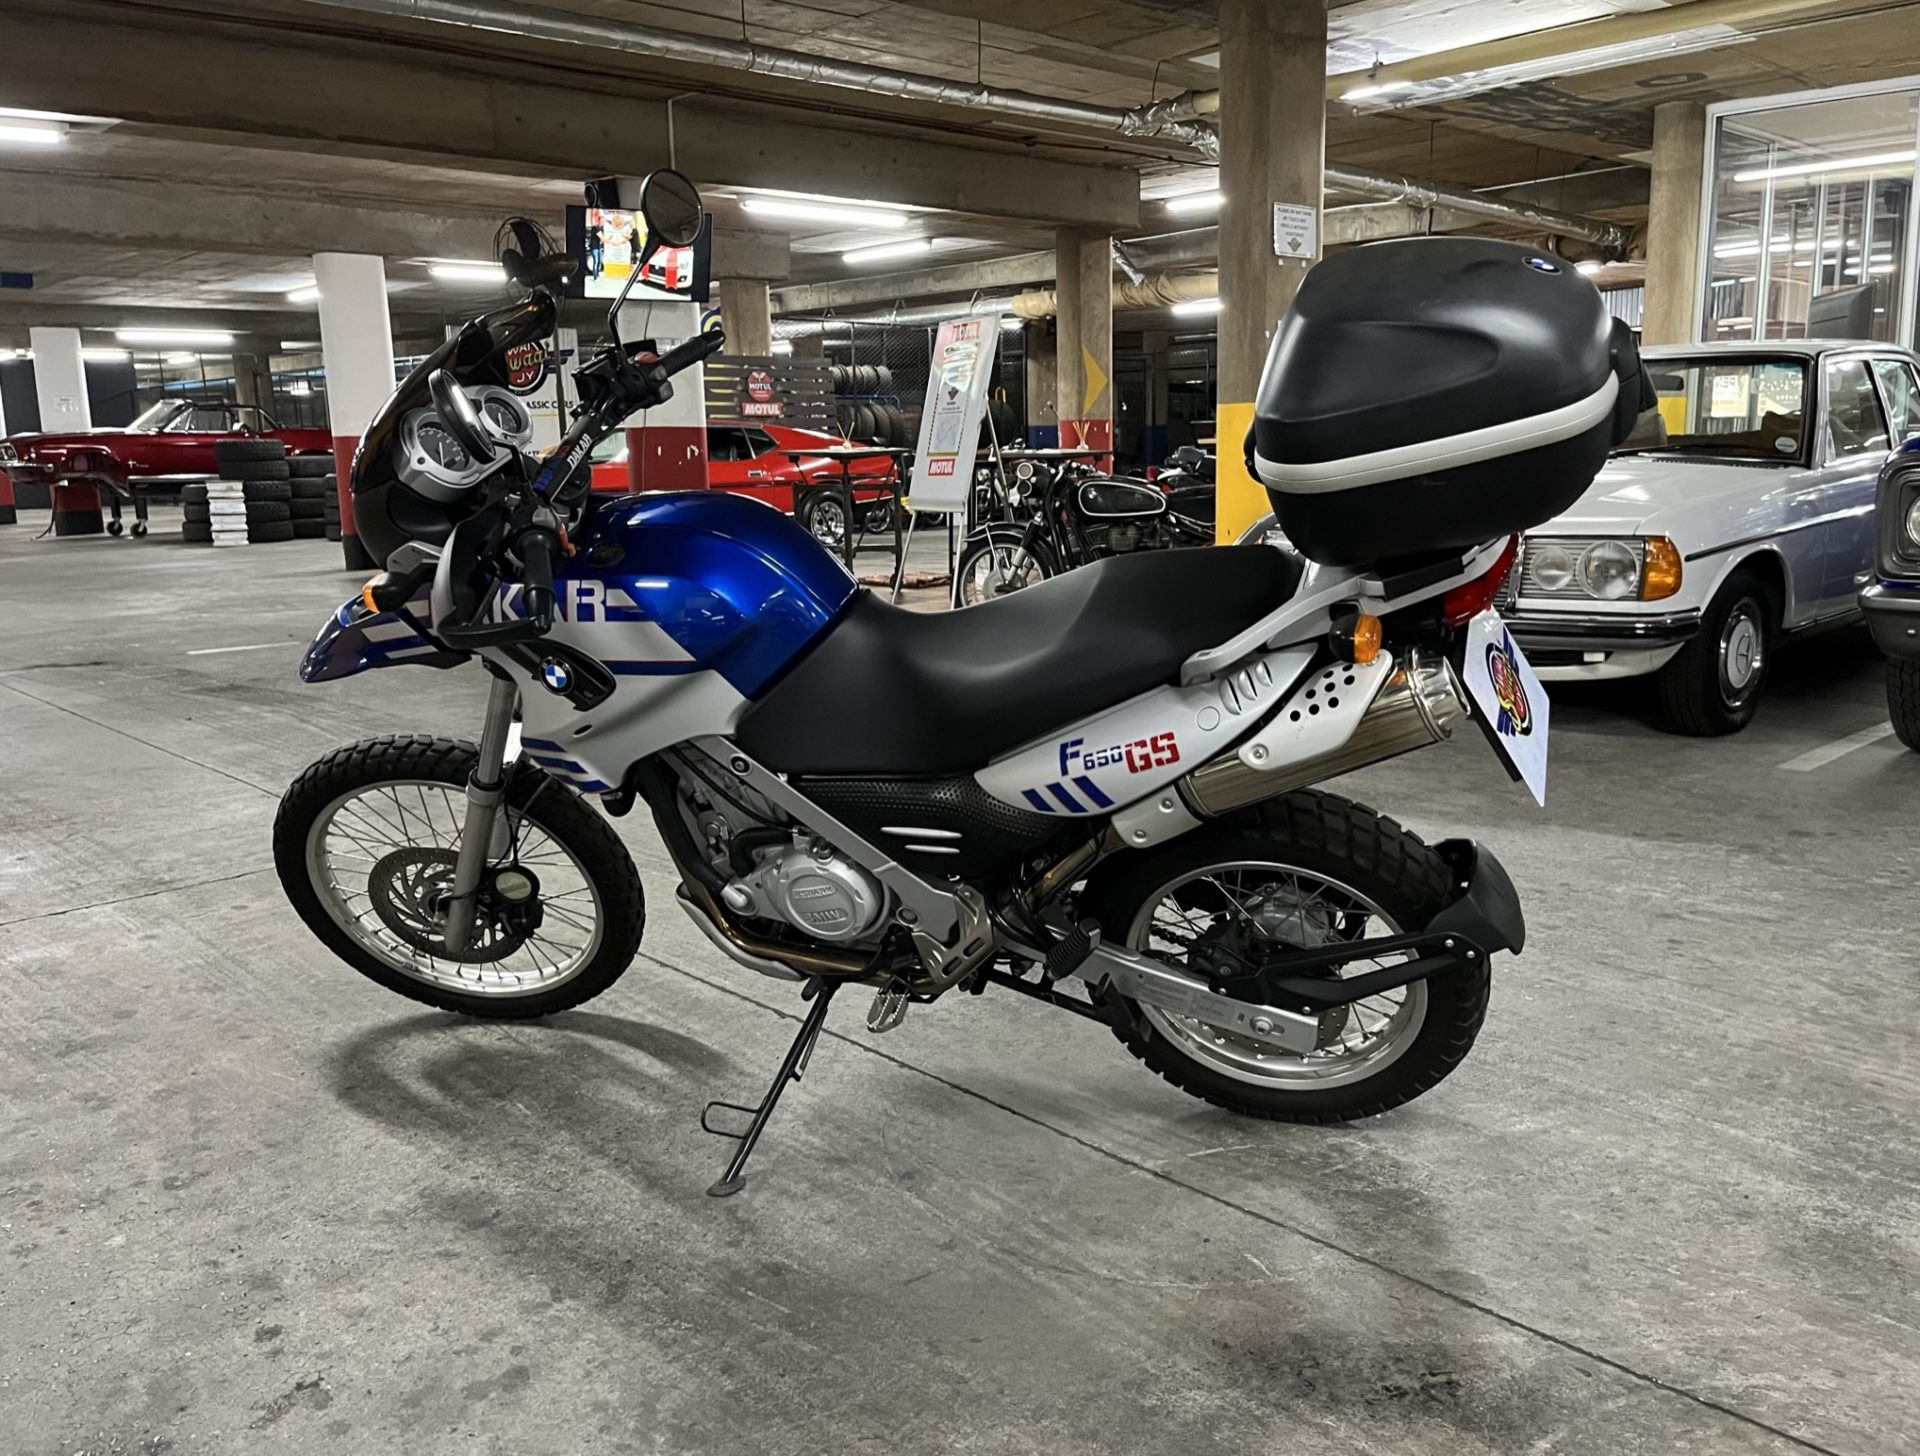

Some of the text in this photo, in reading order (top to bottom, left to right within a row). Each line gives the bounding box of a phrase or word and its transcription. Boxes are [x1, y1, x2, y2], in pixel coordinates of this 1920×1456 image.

[517, 370, 534, 383] JY
[526, 400, 574, 409] ASSIC CRS
[744, 403, 780, 415] MOTUL
[566, 433, 593, 469] DAKAR
[930, 461, 954, 474] MOTUL
[804, 909, 840, 923] BMW
